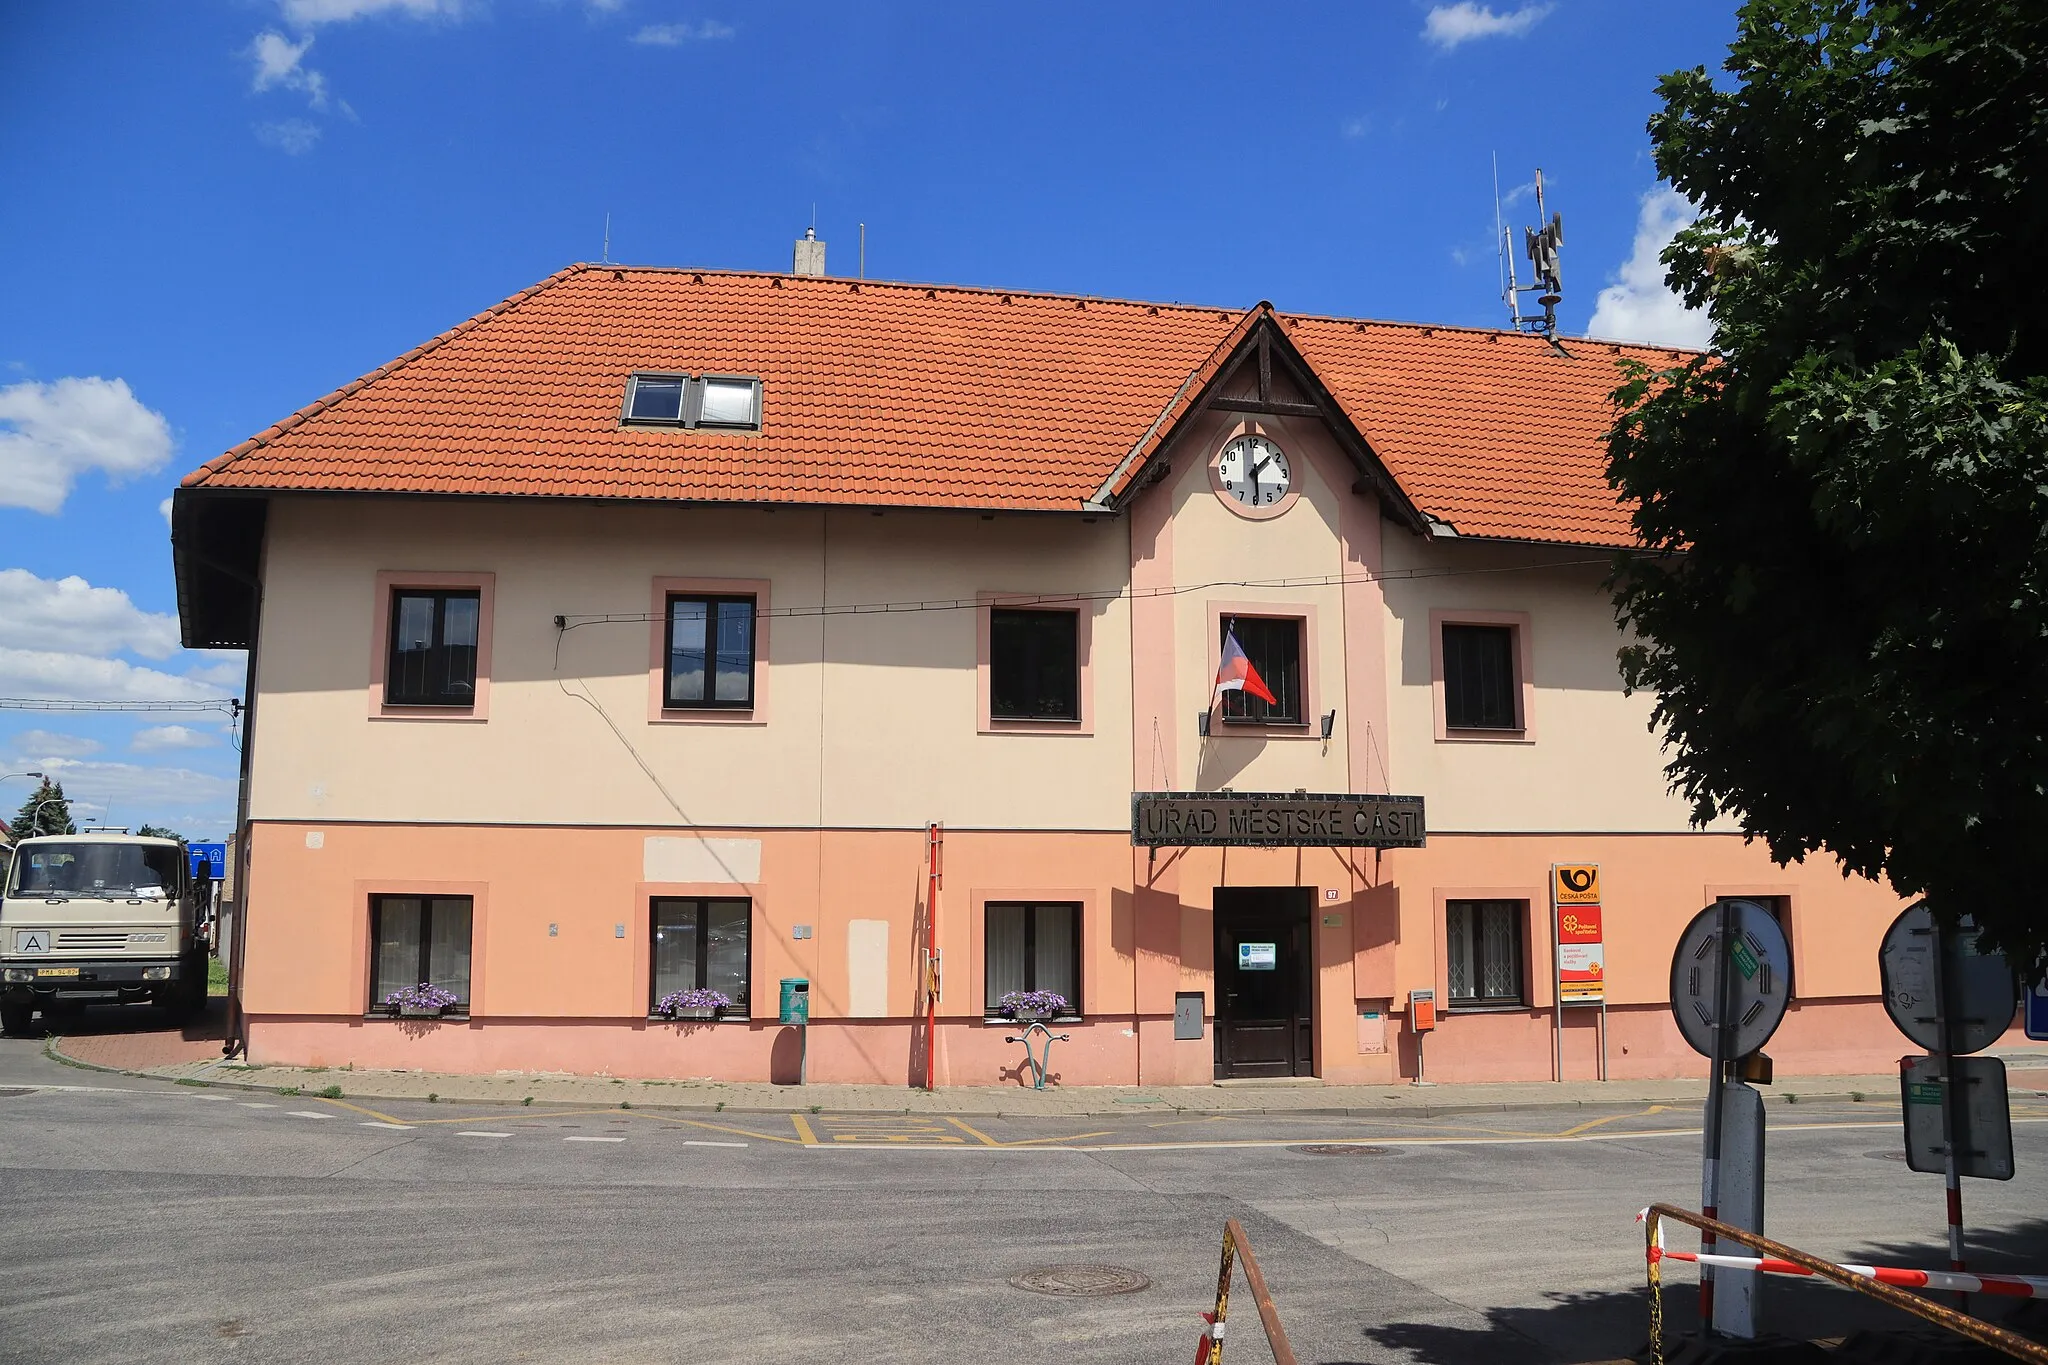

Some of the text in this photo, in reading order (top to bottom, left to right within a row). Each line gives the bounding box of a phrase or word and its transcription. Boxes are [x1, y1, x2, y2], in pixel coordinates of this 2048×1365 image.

[1236, 441, 1245, 452] 11
[1248, 438, 1259, 449] 12
[1225, 451, 1236, 462] 10
[1275, 453, 1281, 463] 2
[1221, 465, 1227, 475] 9
[1281, 469, 1287, 478] 3
[1226, 480, 1232, 490] 8
[1276, 483, 1282, 493] 4
[1239, 491, 1245, 501] 7
[1266, 492, 1273, 502] 5
[1147, 802, 1417, 837] ÚŘAD MĚSTSKÉ ČÁSTI
[1328, 890, 1337, 899] 97
[24, 936, 42, 951] A
